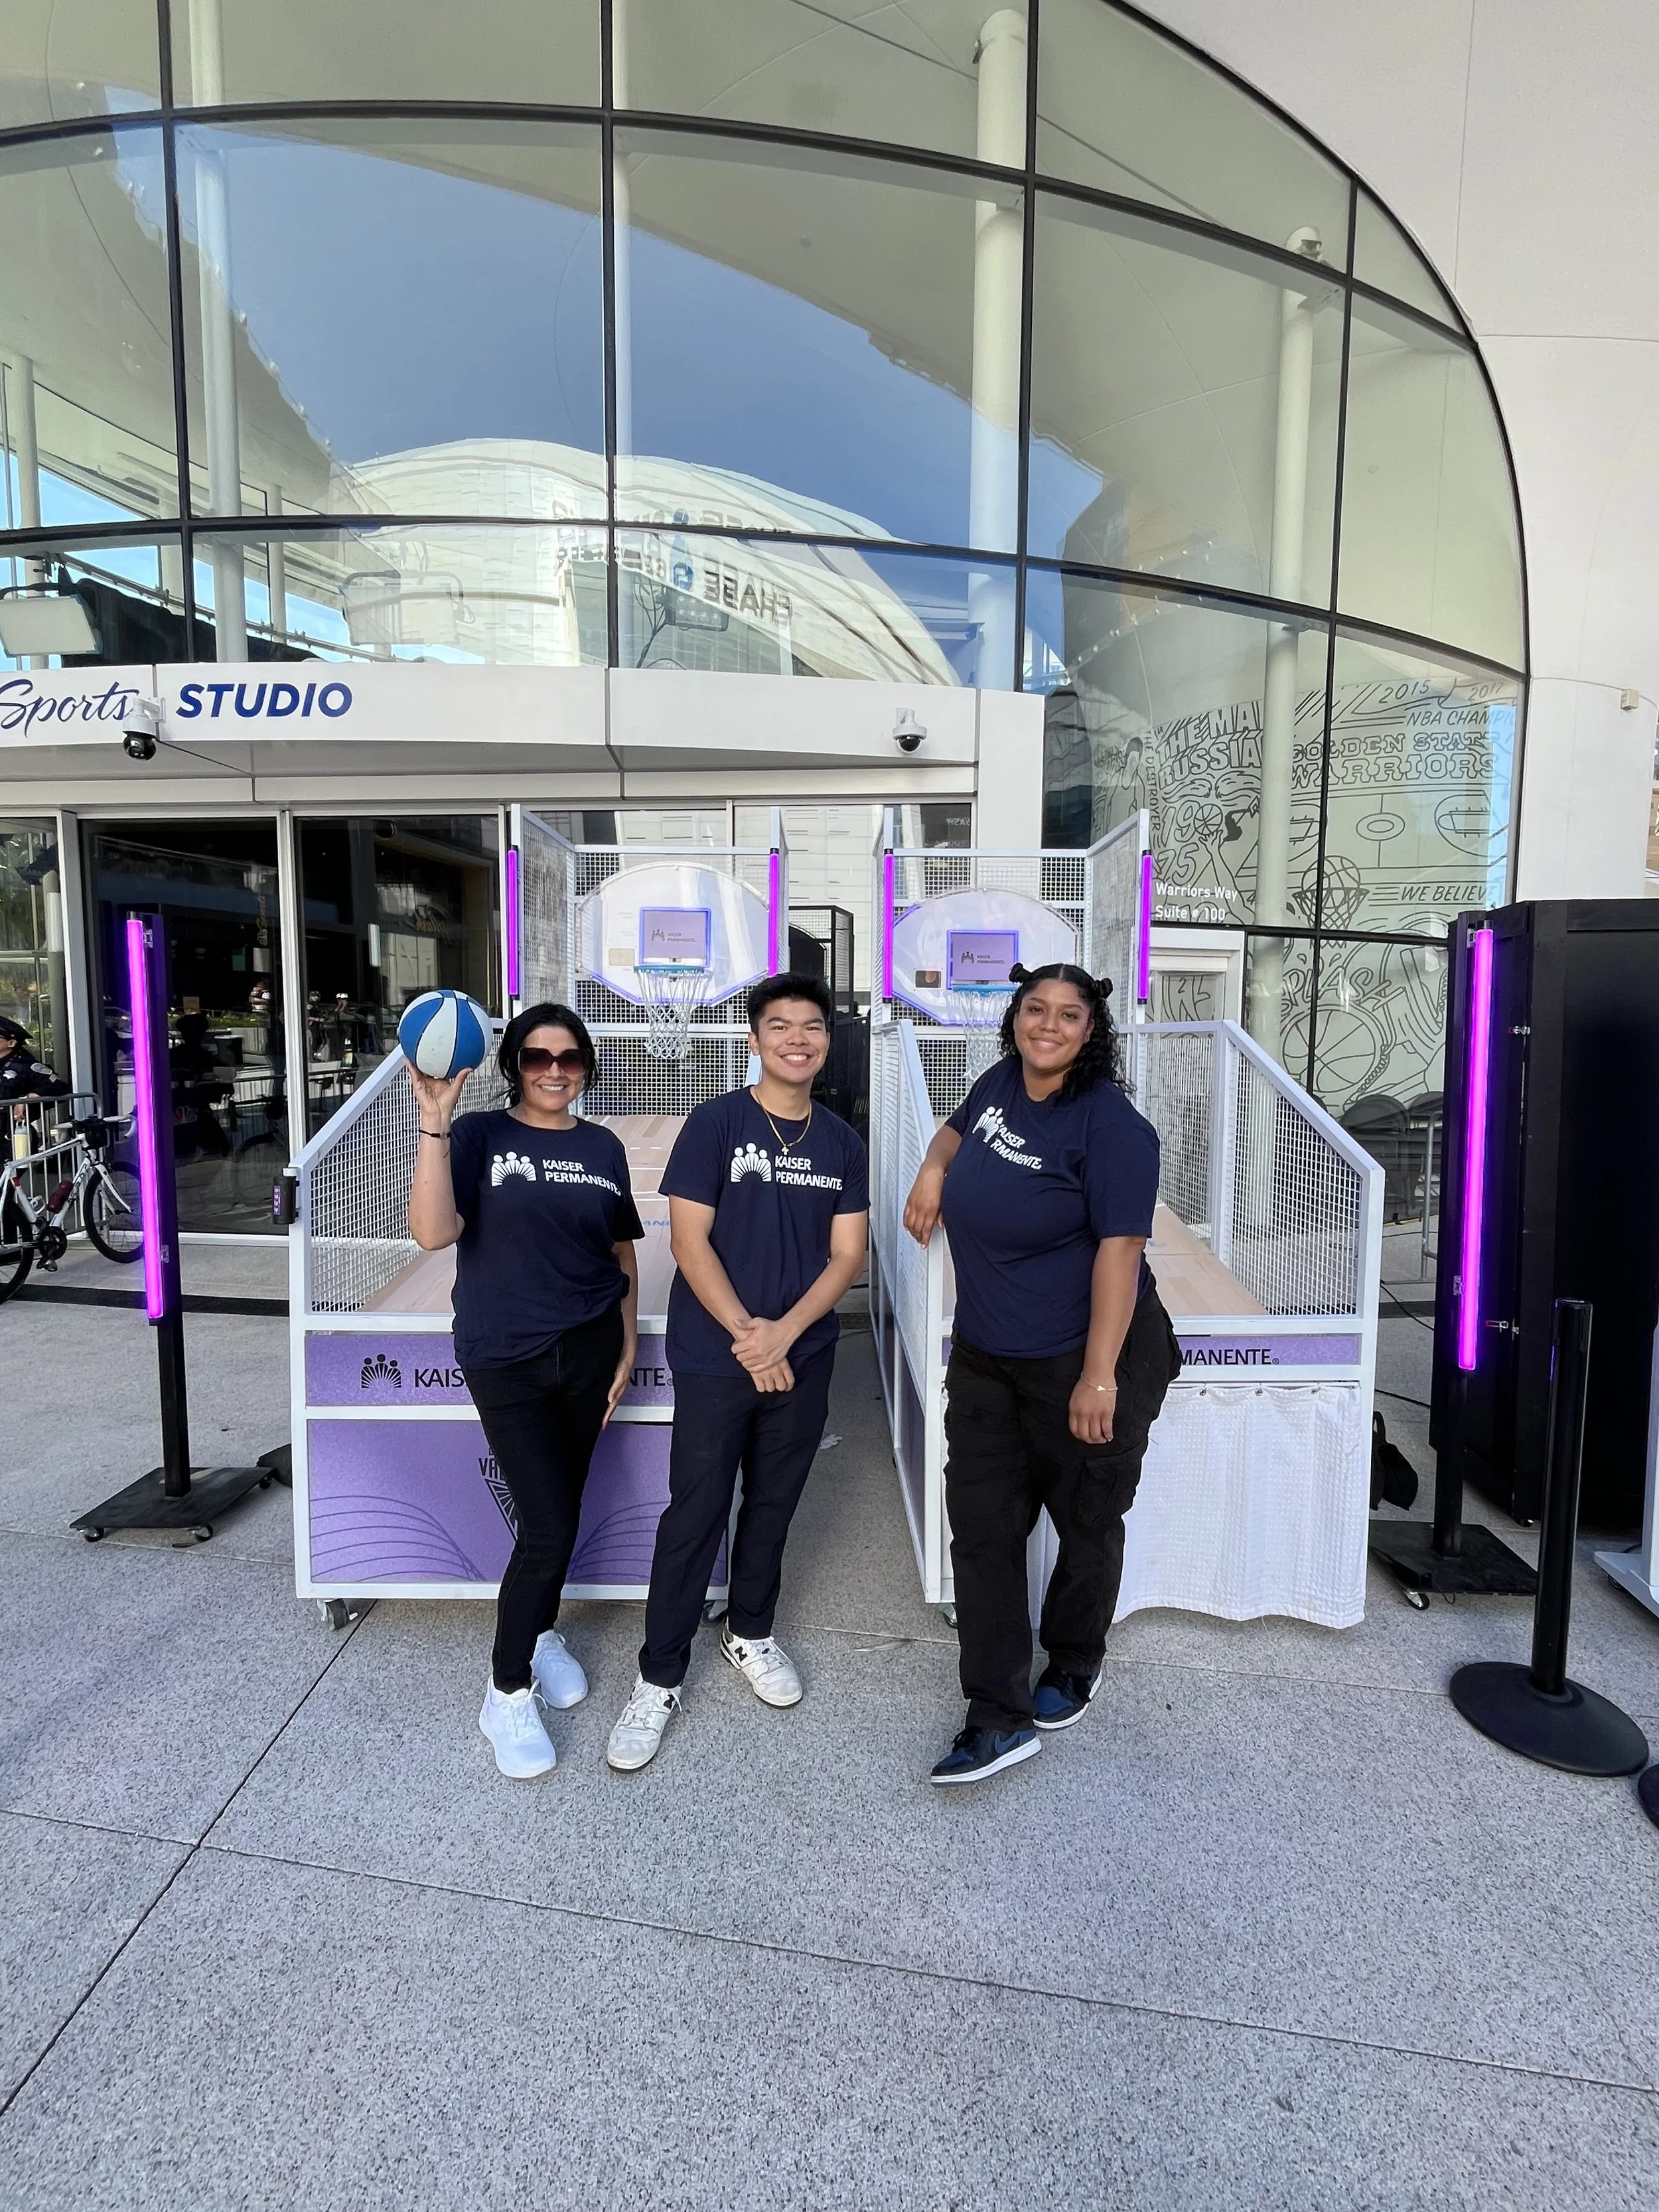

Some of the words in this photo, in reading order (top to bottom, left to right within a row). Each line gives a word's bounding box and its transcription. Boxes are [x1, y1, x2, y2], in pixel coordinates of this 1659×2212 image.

[1378, 679, 1430, 704] 2015
[1469, 682, 1504, 701] 2017
[0, 679, 139, 738] Sports
[176, 682, 353, 718] STUDIO
[1406, 710, 1443, 727] NBA
[1156, 717, 1201, 764] THE
[1208, 701, 1263, 740] MA
[1145, 756, 1161, 832] DESTROYER
[1156, 882, 1211, 898] Warriors
[1214, 886, 1238, 902] Way
[1401, 885, 1431, 902] WE
[1155, 905, 1188, 919] Suite
[1204, 907, 1226, 921] 100
[541, 1159, 585, 1173] KAISER
[774, 1155, 812, 1171] KAISER
[545, 1170, 621, 1196] PERMANENTE
[774, 1170, 843, 1191] PERMANENTE
